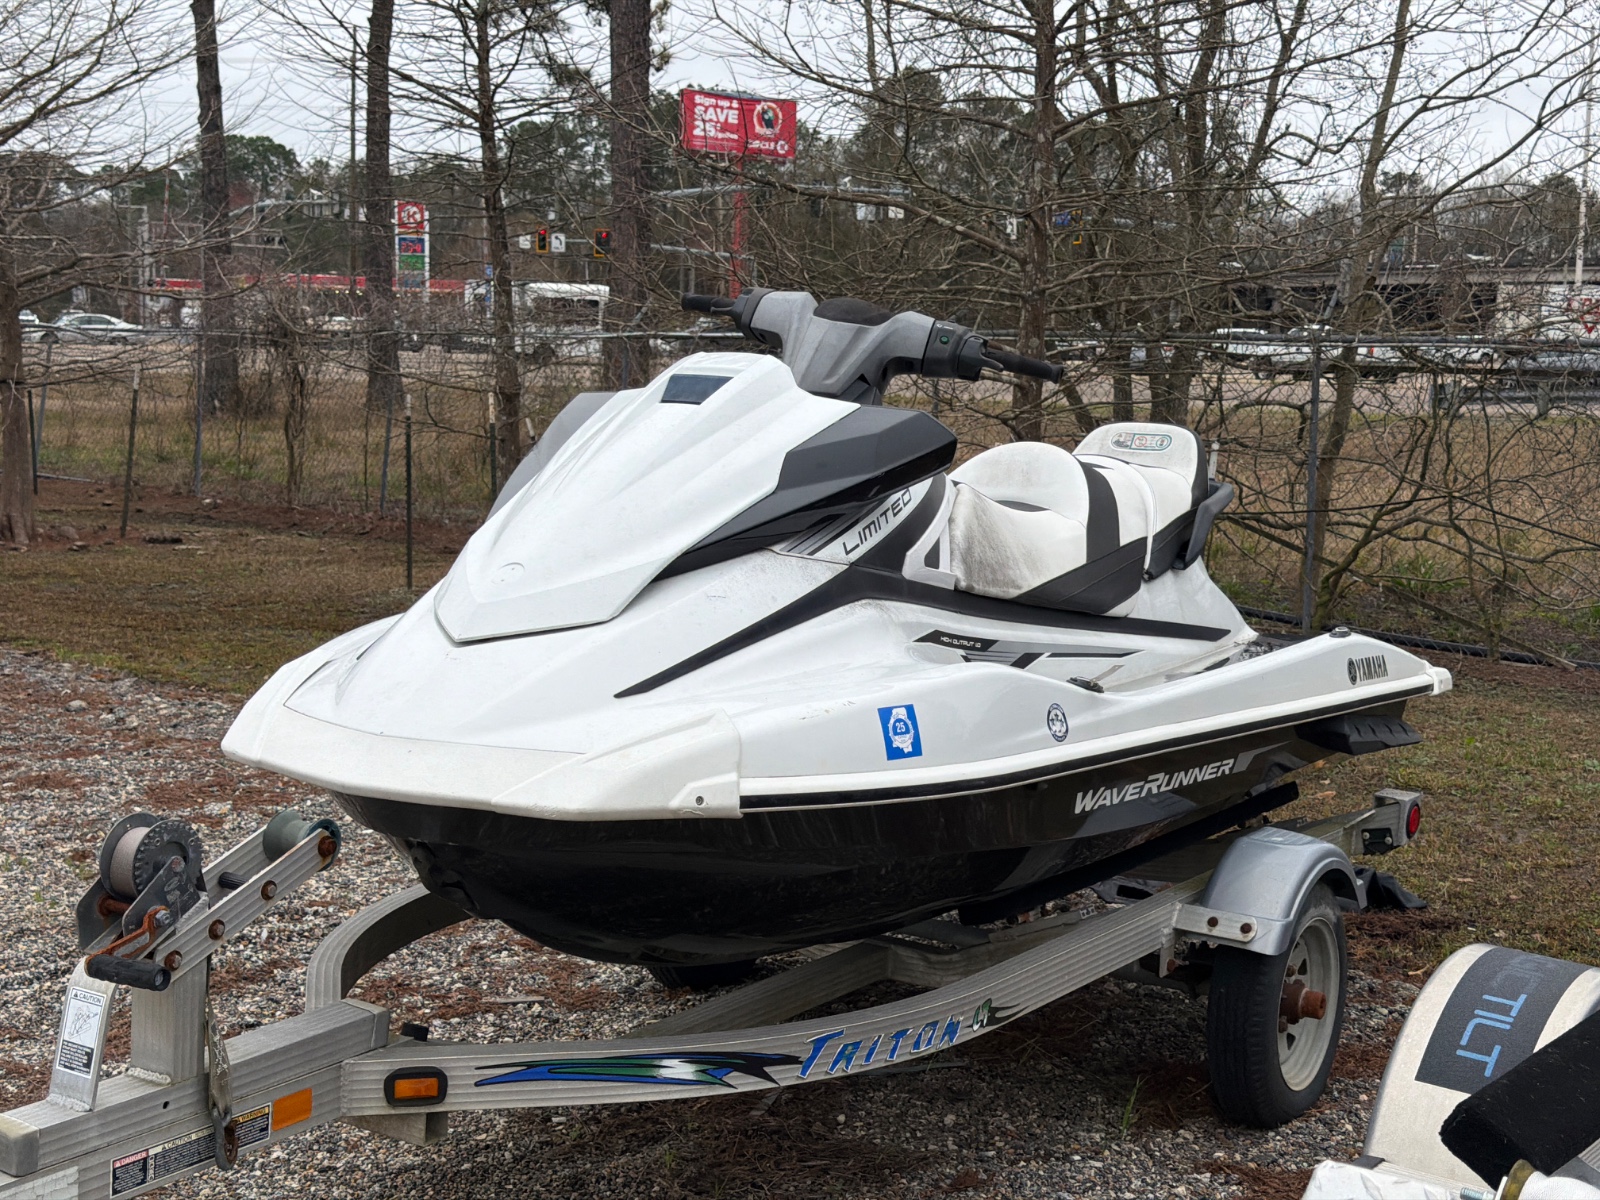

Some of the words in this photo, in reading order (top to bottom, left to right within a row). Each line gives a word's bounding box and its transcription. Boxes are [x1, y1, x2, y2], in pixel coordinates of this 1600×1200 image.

[694, 94, 717, 106] Sign
[717, 99, 731, 108] up
[731, 99, 739, 108] &
[694, 105, 739, 124] SAVE
[842, 487, 912, 556] LIMITED
[952, 638, 975, 647] OUTPUT
[1355, 654, 1389, 682] YAMAHA
[895, 721, 906, 733] 25
[78, 992, 102, 1005] CAUTION
[1455, 993, 1528, 1077] TILT
[796, 1014, 965, 1080] TRITON
[240, 1107, 266, 1122] WARNING
[166, 1134, 193, 1149] CAUTION
[120, 1151, 147, 1166] DANGER
